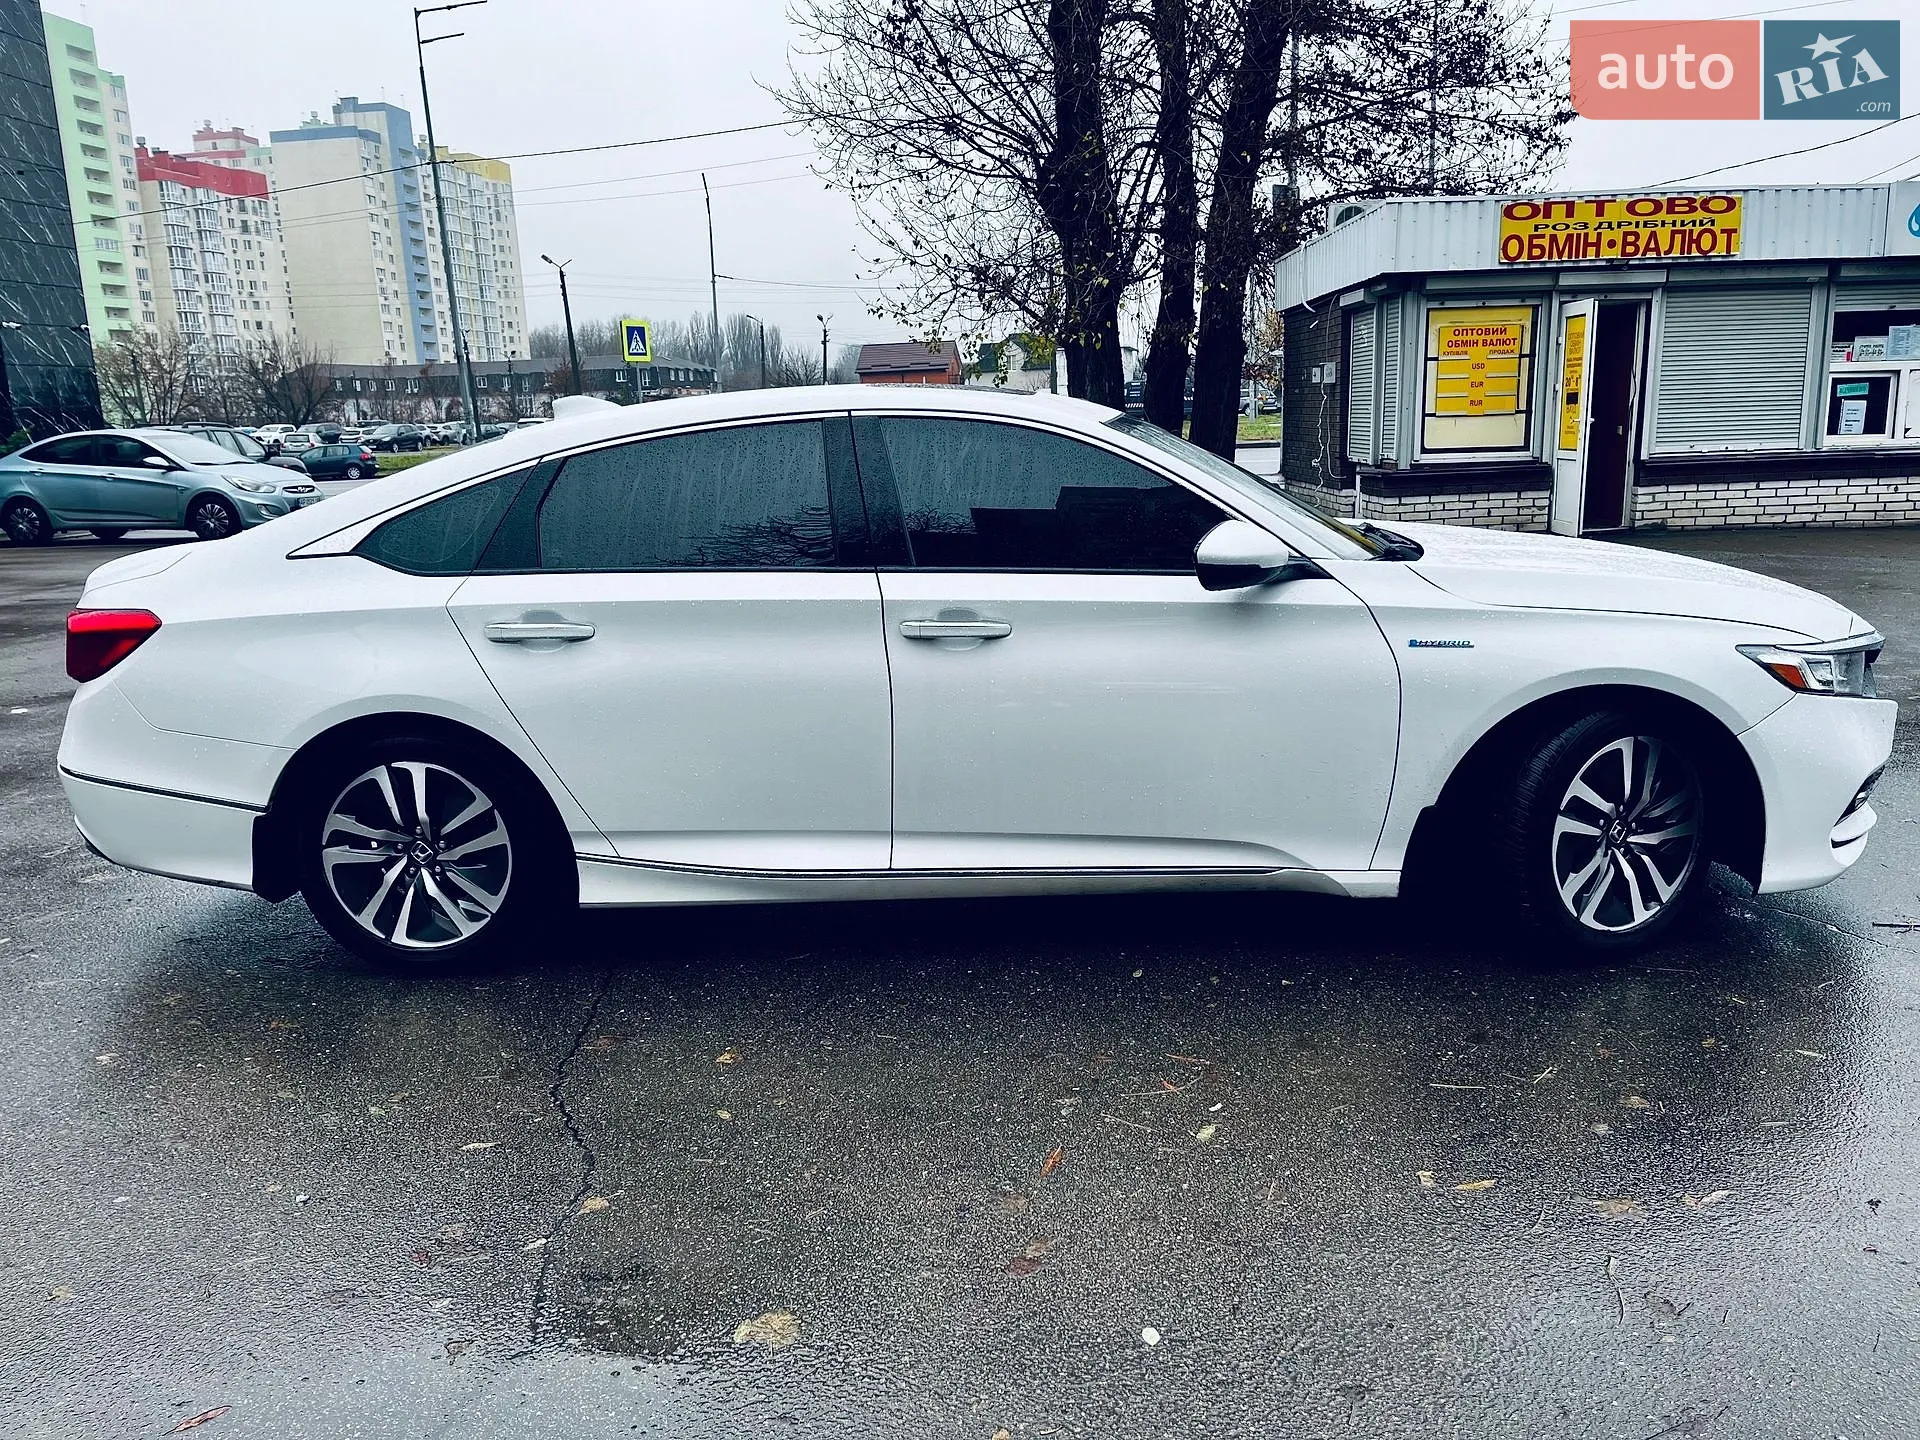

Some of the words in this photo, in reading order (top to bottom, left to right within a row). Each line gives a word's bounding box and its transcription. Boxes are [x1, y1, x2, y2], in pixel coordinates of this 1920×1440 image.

[1502, 195, 1737, 221] ОПТОВО
[1453, 325, 1507, 337] ОПТОВИЙ
[1447, 339, 1479, 348] ОБМІН
[1482, 338, 1518, 347] ВАЛЮТ
[1418, 639, 1471, 647] HYBRID
